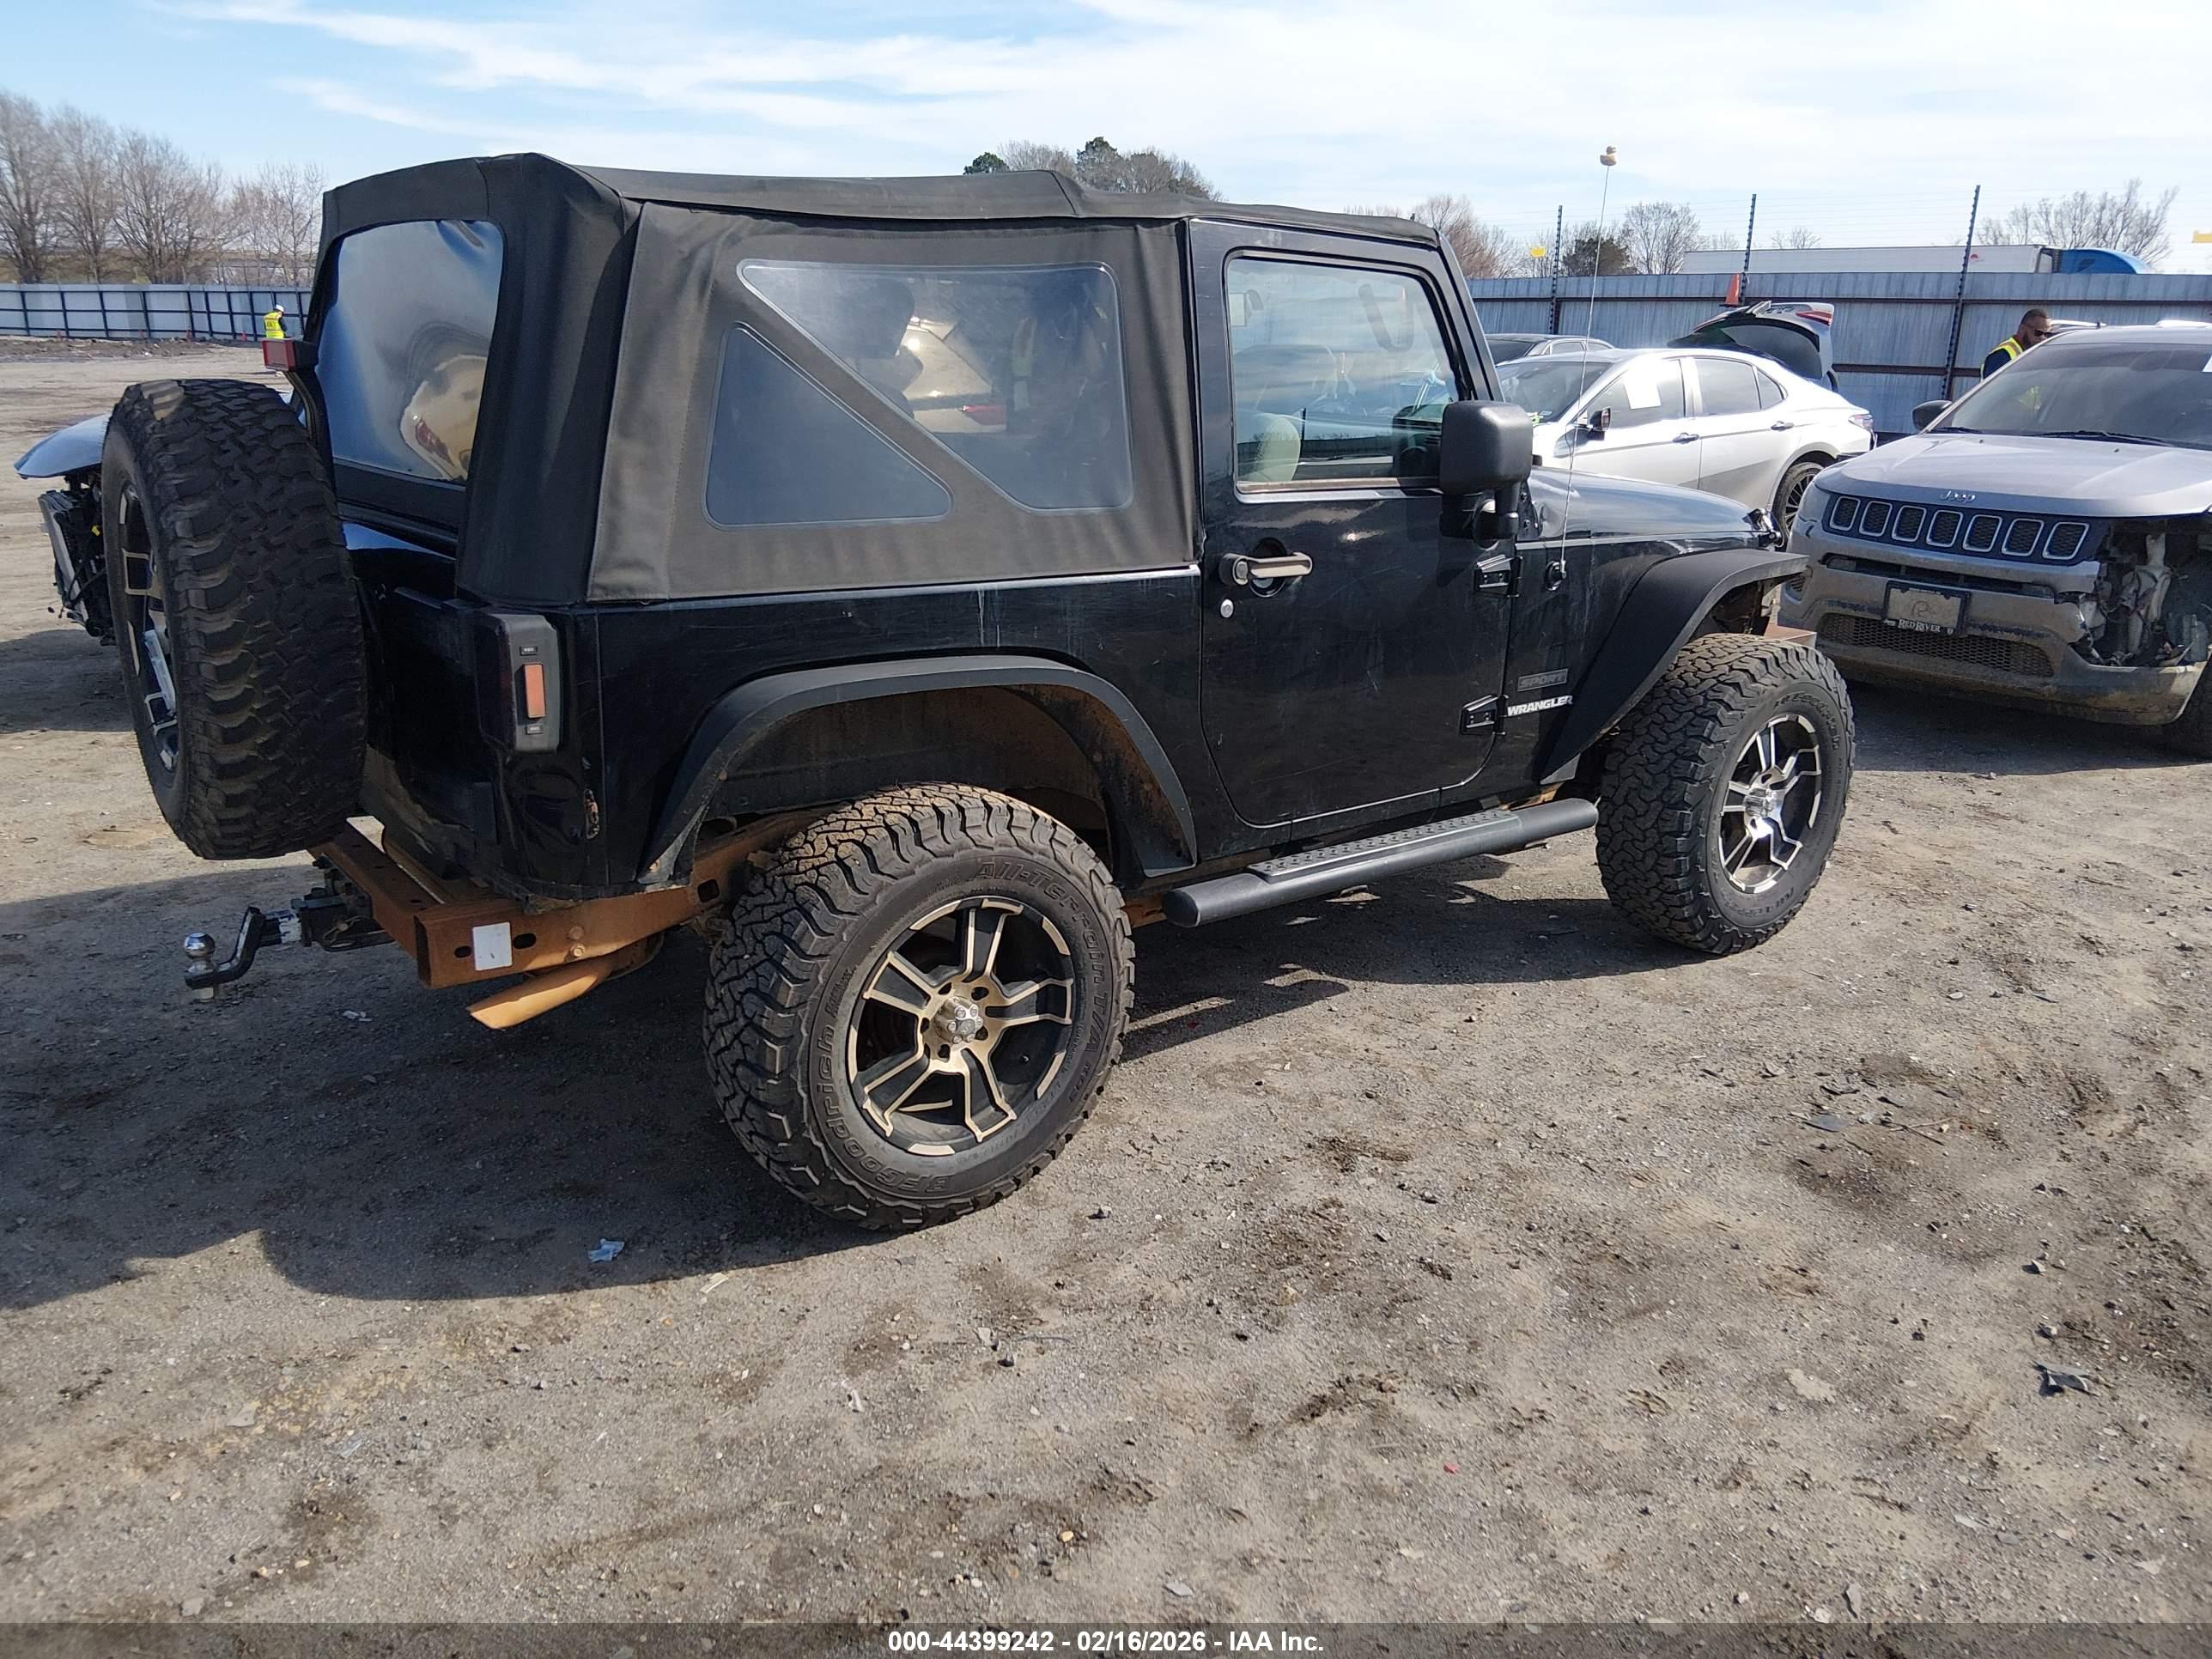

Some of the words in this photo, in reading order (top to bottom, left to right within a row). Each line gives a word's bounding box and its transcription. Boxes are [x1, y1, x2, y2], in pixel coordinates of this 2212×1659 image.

[1940, 489, 1976, 502] Jeep
[1898, 619, 1916, 631] RED
[1915, 621, 1941, 634] RIVER
[1519, 672, 1567, 689] SPORT
[1507, 695, 1573, 717] WRANGLER
[817, 1024, 950, 1194] BFGoodrich
